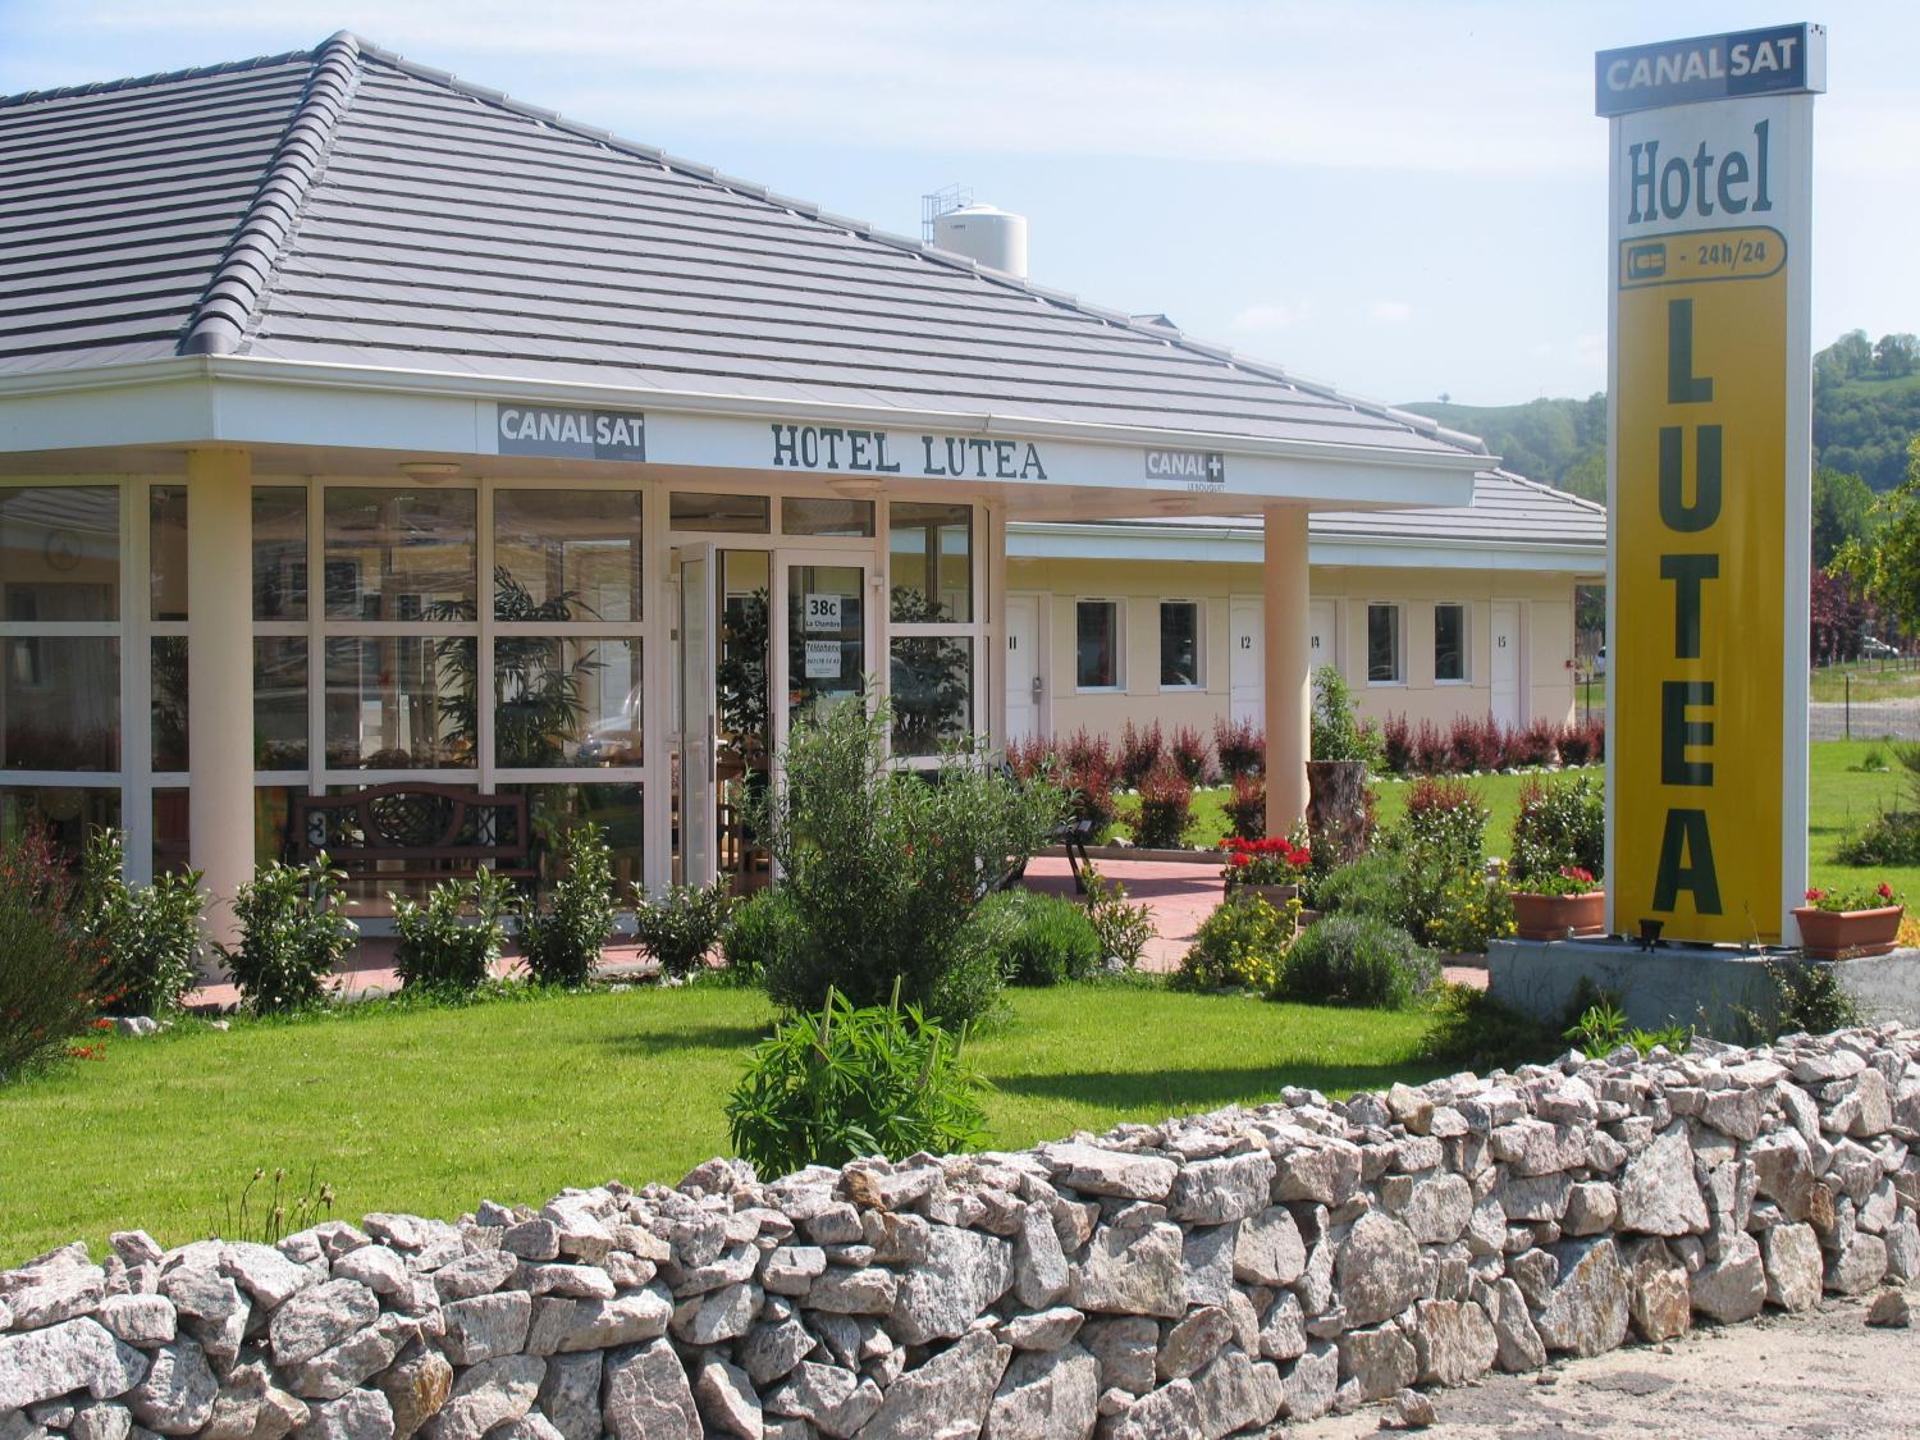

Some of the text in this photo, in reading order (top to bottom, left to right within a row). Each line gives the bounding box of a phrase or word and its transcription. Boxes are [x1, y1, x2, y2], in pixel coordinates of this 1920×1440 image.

[1627, 118, 1773, 224] Hotel
[1697, 239, 1767, 270] 24h/24
[771, 424, 1048, 481] HOTEL LUTEA
[1652, 297, 1723, 916] LUTEA
[1240, 635, 1252, 650] 12
